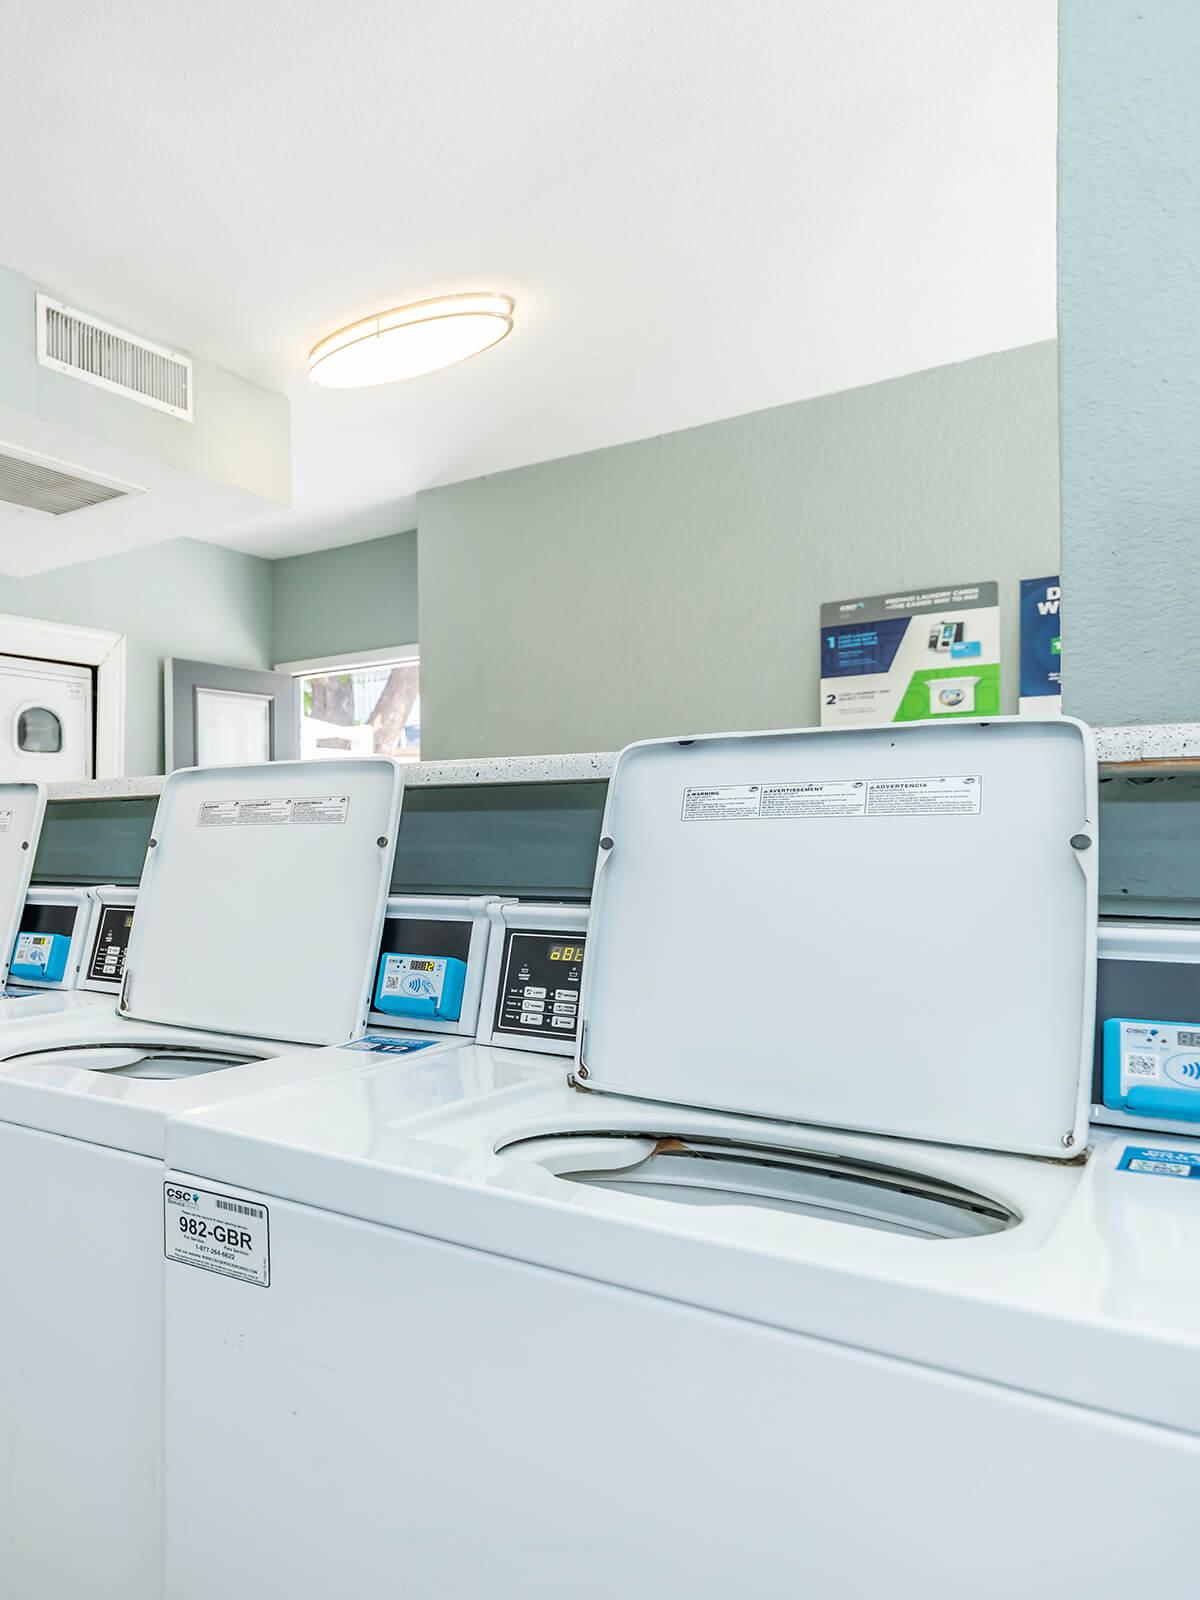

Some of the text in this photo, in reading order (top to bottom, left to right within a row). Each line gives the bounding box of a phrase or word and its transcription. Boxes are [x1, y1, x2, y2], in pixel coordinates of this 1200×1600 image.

[826, 636, 835, 649] 1
[826, 694, 836, 705] 2
[166, 1188, 191, 1202] CSC
[179, 1216, 253, 1251] 982-GBR
